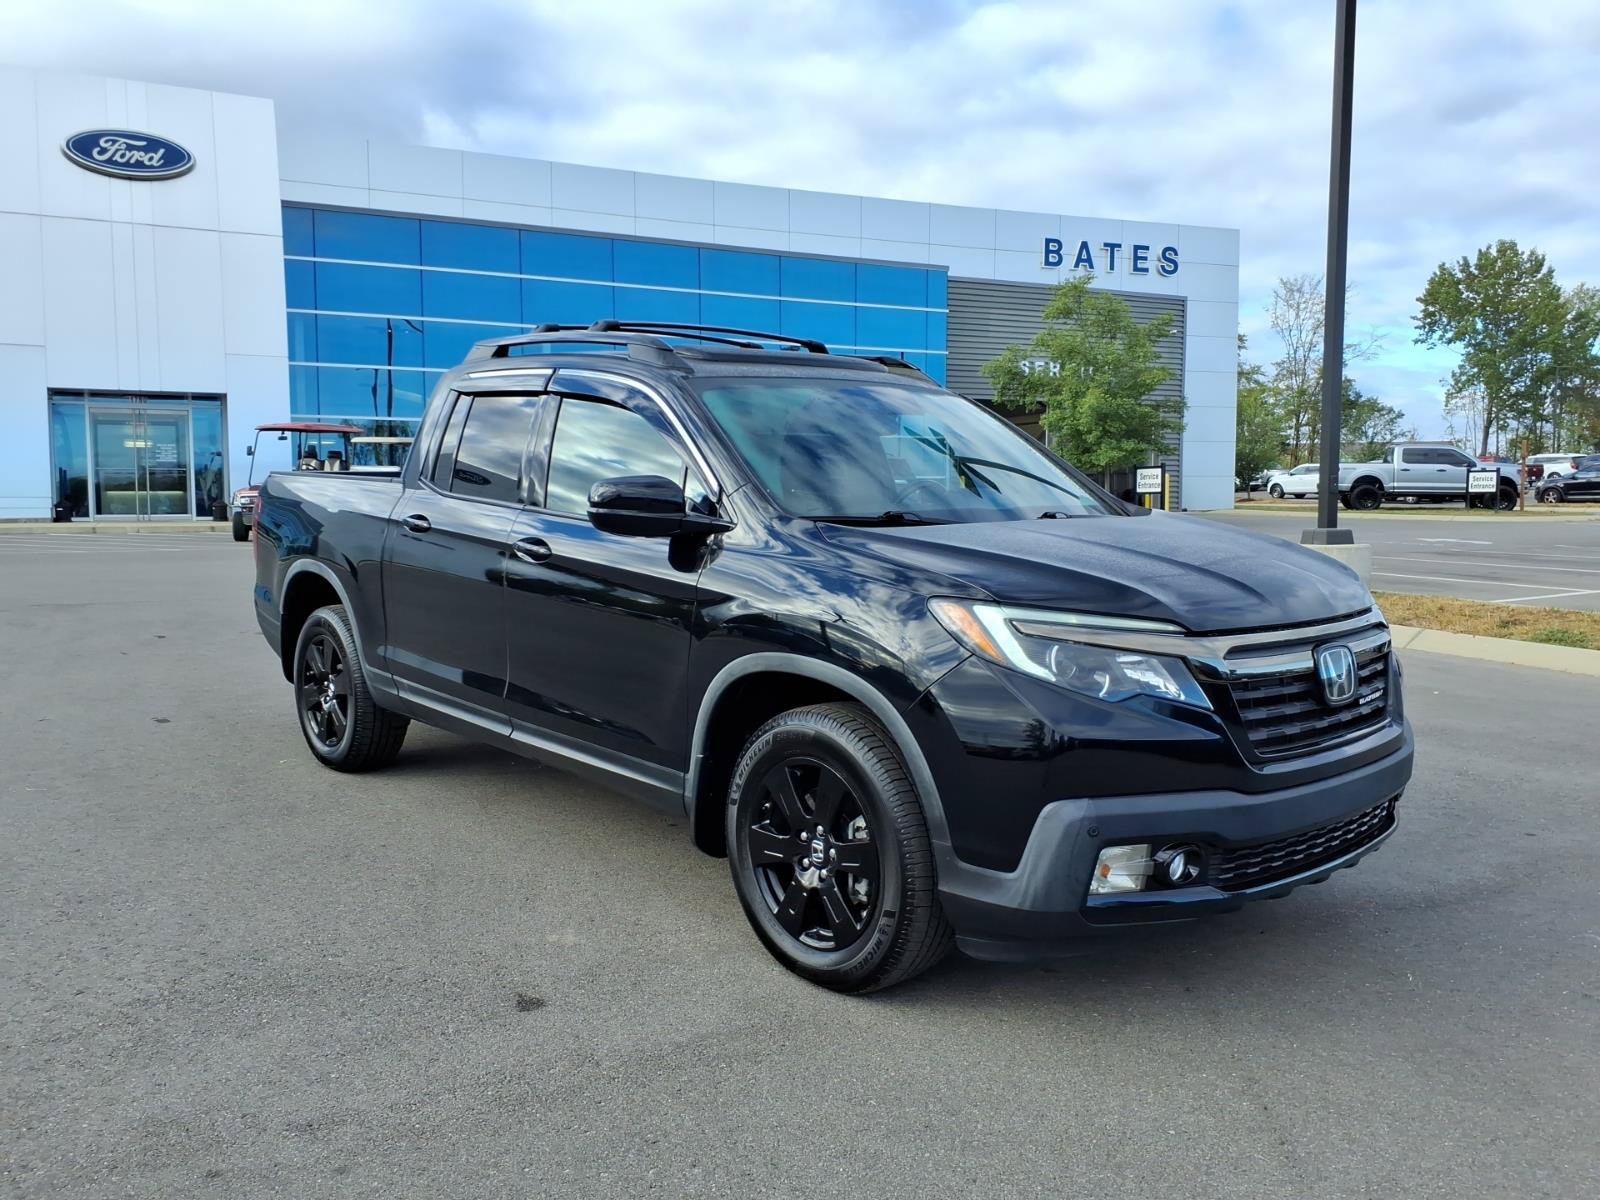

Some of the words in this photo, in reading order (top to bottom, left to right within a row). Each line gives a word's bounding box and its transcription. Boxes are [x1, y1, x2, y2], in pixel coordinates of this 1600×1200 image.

[92, 136, 165, 166] Ford
[1042, 237, 1179, 275] BATES
[1139, 472, 1159, 480] Service
[737, 733, 773, 782] MICHELIN
